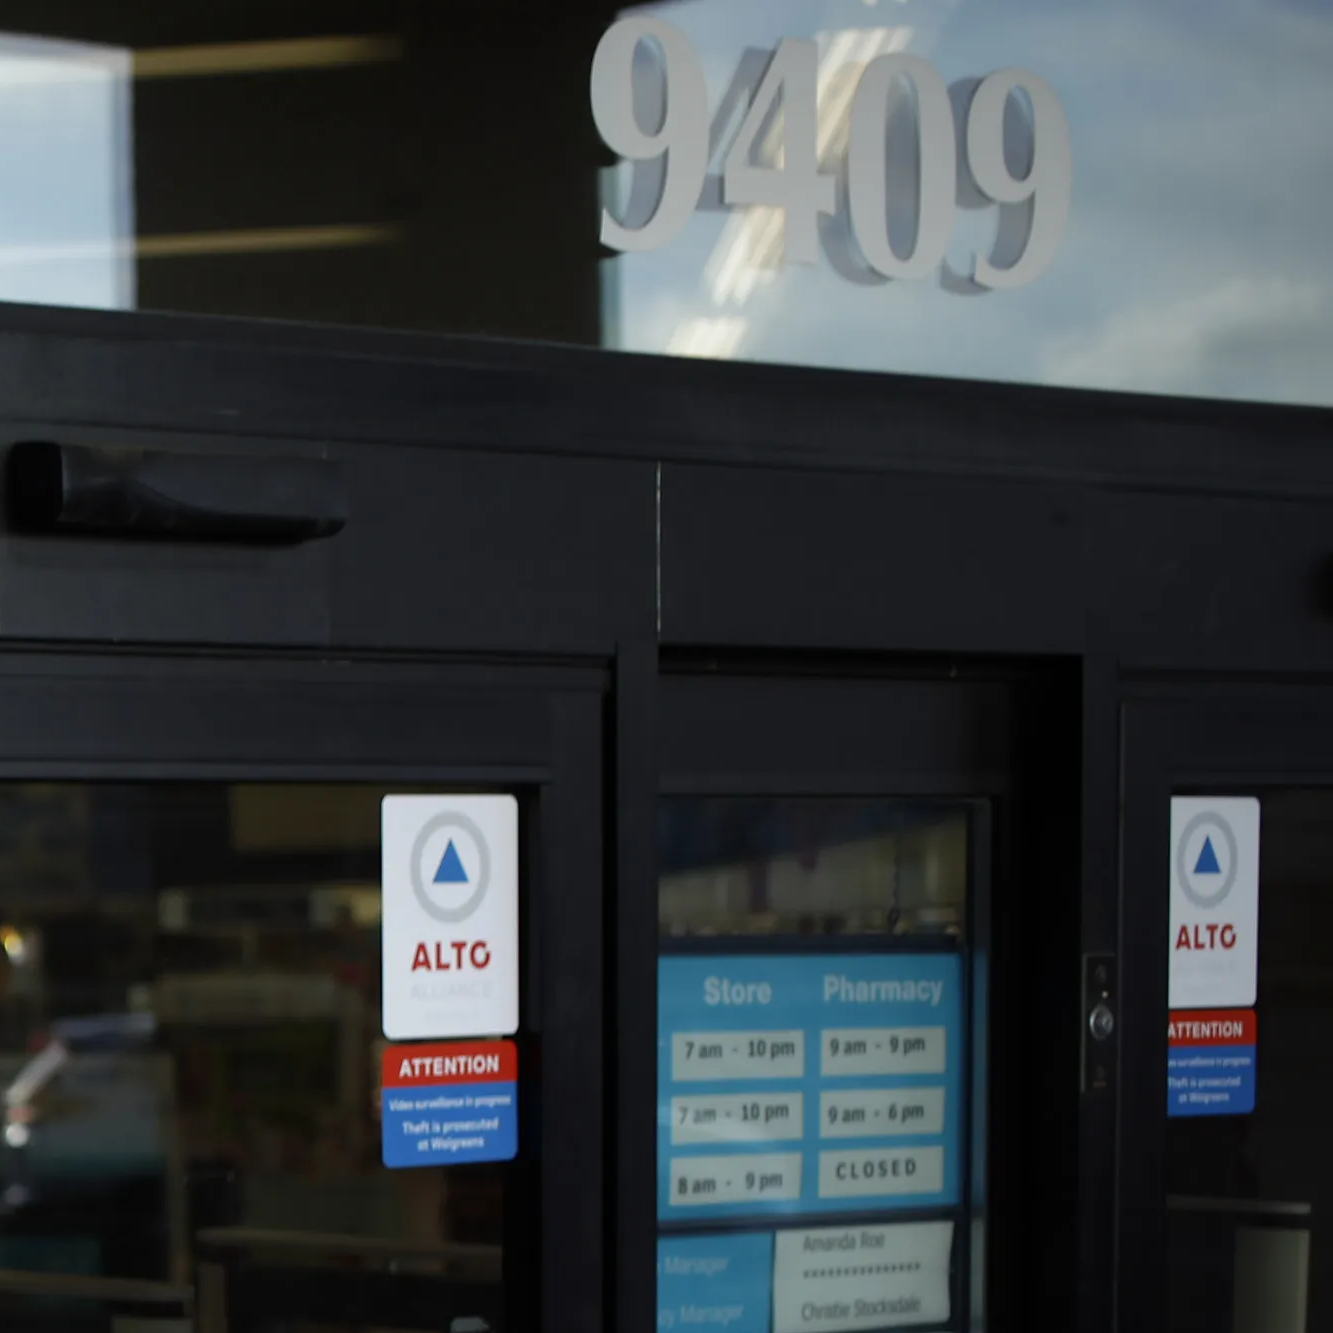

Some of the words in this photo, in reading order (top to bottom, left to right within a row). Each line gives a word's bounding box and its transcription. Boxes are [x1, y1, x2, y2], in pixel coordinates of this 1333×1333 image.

[590, 17, 1072, 289] 9409
[1176, 924, 1236, 951] ALTO
[411, 940, 491, 972] ALTO
[704, 975, 772, 1005] Store
[823, 974, 943, 1007] Pharmacy
[1168, 1021, 1244, 1040] ATTENTION
[685, 1042, 694, 1060] 7
[698, 1045, 723, 1059] am
[748, 1040, 768, 1056] 10
[770, 1041, 795, 1060] pm
[830, 1038, 840, 1058] 9
[843, 1041, 867, 1055] am
[903, 1037, 926, 1055] pm
[399, 1054, 500, 1078] ATTENTION
[693, 1108, 716, 1123] am
[741, 1104, 761, 1121] 10
[765, 1103, 789, 1125] pm
[842, 1108, 865, 1123] am
[901, 1103, 924, 1124] pm
[402, 1121, 430, 1135] Theft
[432, 1120, 441, 1133] is
[443, 1117, 499, 1135] prosecuted
[836, 1158, 916, 1180] CLOSED
[692, 1178, 716, 1194] am
[759, 1172, 783, 1192] pm
